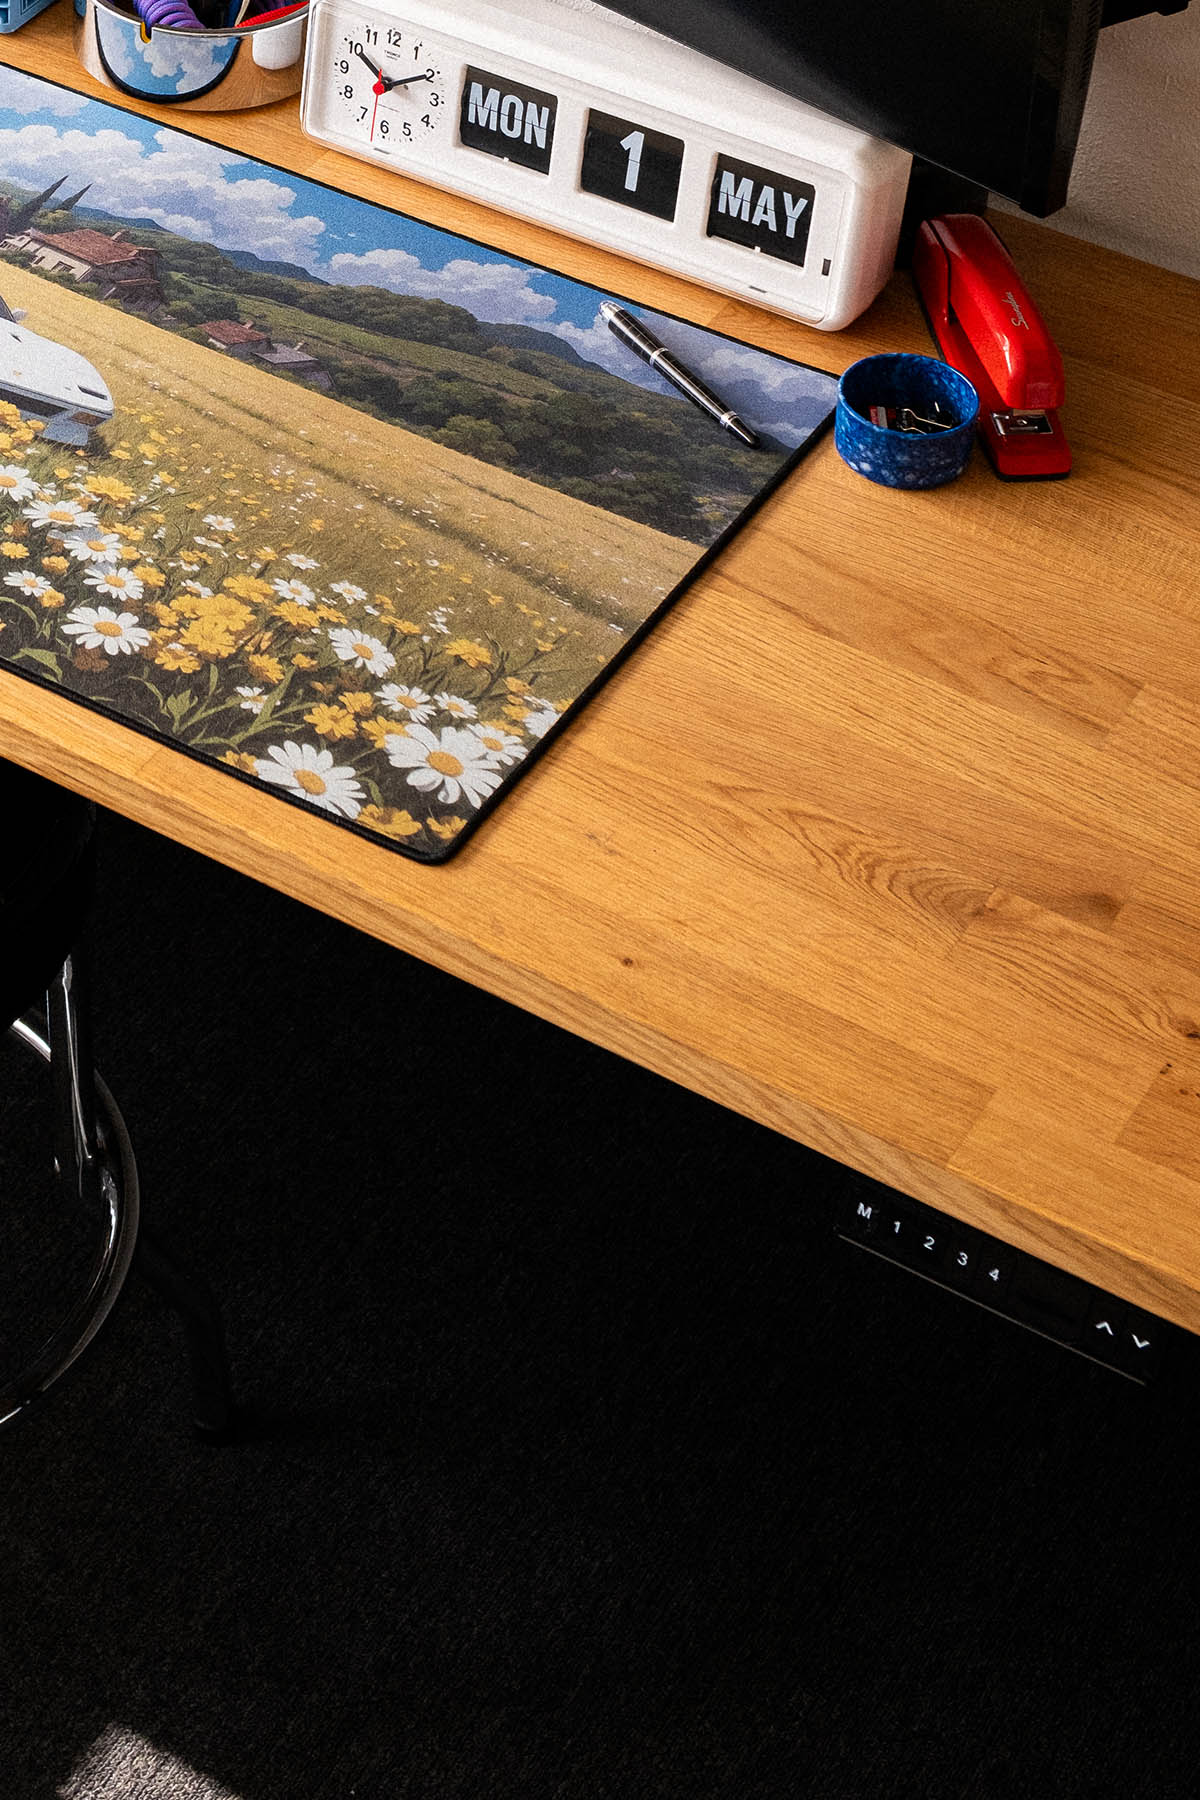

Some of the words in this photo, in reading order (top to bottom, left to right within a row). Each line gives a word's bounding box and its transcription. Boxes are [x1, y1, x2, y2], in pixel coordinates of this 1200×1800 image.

[366, 28, 378, 46] 11
[387, 29, 402, 48] 12
[348, 40, 364, 57] 10
[413, 45, 420, 61] 1
[339, 59, 350, 74] 9
[425, 68, 436, 84] 2
[343, 85, 354, 99] 8
[429, 92, 440, 107] 3
[360, 105, 369, 120] 7
[380, 119, 390, 135] 6
[402, 121, 412, 137] 5
[420, 114, 431, 128] 4
[467, 82, 550, 150] MON
[620, 131, 646, 193] 1
[717, 171, 809, 239] MAY
[857, 1202, 873, 1220] M
[893, 1220, 901, 1233] 1
[923, 1235, 936, 1250] 2
[956, 1251, 969, 1267] 3
[989, 1267, 1000, 1282] 4
